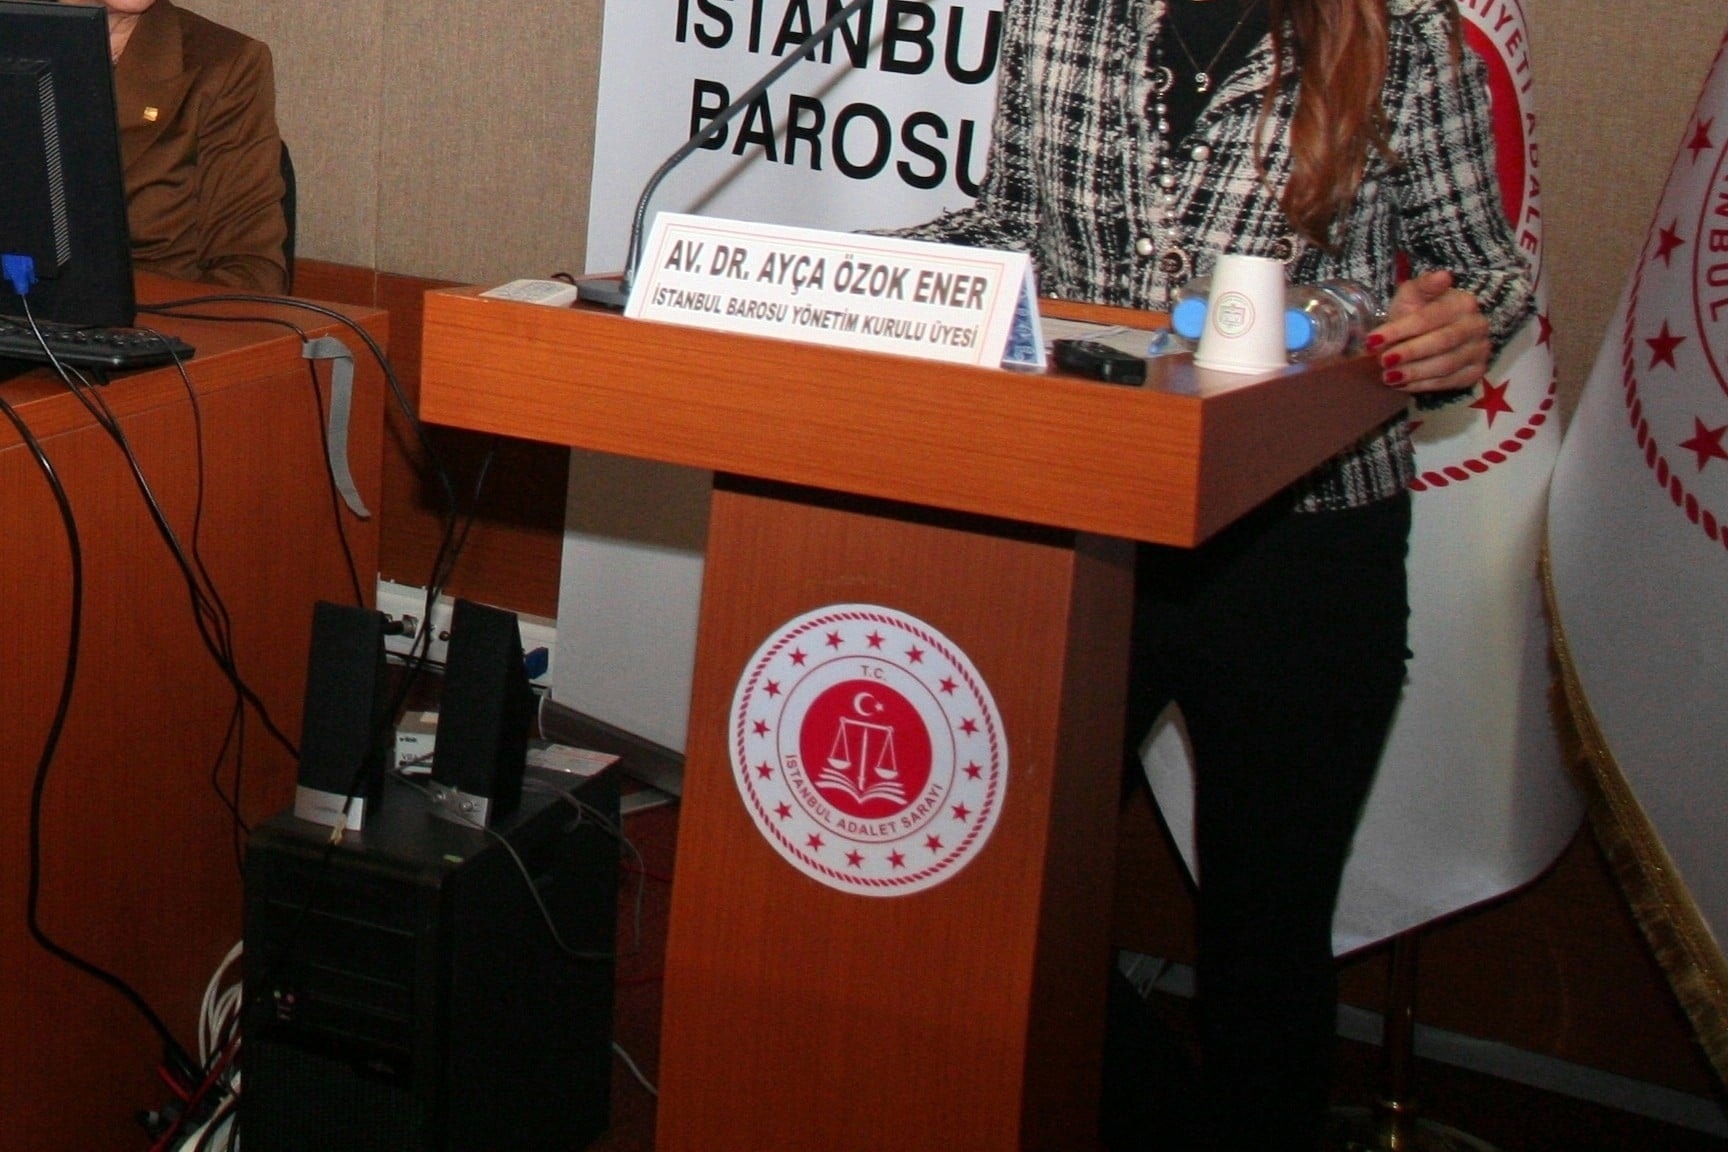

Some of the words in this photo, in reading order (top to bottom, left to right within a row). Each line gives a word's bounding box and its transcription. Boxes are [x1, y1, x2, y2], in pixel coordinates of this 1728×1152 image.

[663, 239, 703, 274] AV.
[710, 244, 749, 280] DR.
[756, 251, 826, 296] AYÇA
[833, 253, 910, 301] ÖZOK
[912, 269, 989, 310] ENER
[651, 283, 723, 316] İSTANBUL
[726, 298, 787, 322] BAROSU
[790, 303, 859, 333] YÖNETİM
[861, 314, 927, 342] KURULU
[928, 319, 981, 349] ÜYESİ
[860, 664, 887, 681] T.C.
[836, 818, 898, 837] ADALET
[902, 784, 943, 828] SARAYI
